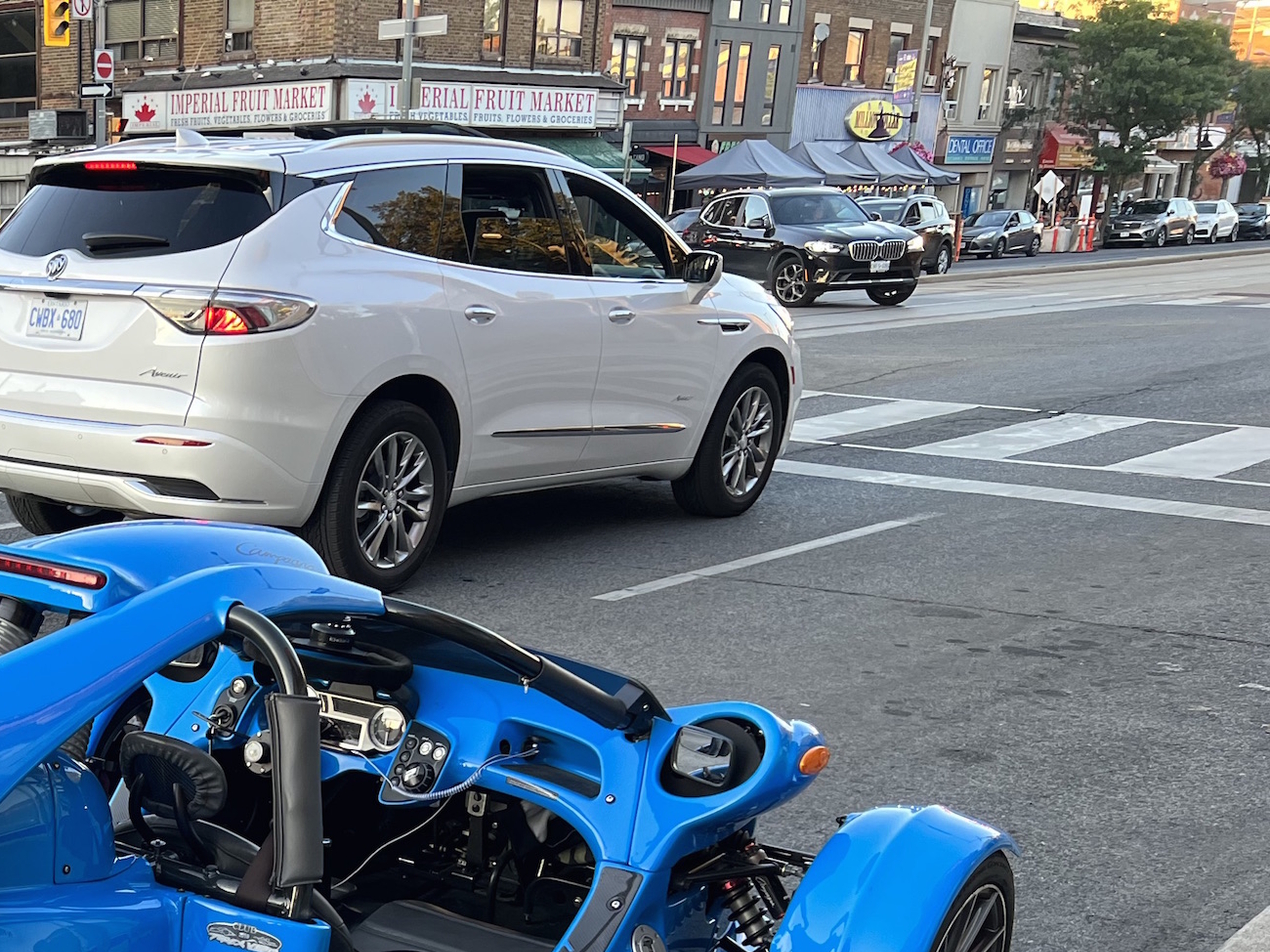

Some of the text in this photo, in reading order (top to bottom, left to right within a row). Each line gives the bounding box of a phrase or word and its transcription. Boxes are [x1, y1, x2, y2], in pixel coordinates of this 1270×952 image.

[170, 85, 327, 115] IMPERIAL FRUIT MARKET
[390, 85, 595, 113] IERIAL FRUIT MARKET
[170, 118, 189, 127] FRESH
[253, 113, 283, 123] FLOWERS
[289, 110, 326, 121] GROCERIES
[506, 114, 541, 124] FLOWERS
[550, 115, 593, 125] GROCERIES
[948, 139, 971, 154] DENTAL
[972, 139, 993, 154] OFFICE
[29, 307, 82, 330] CWBX 680
